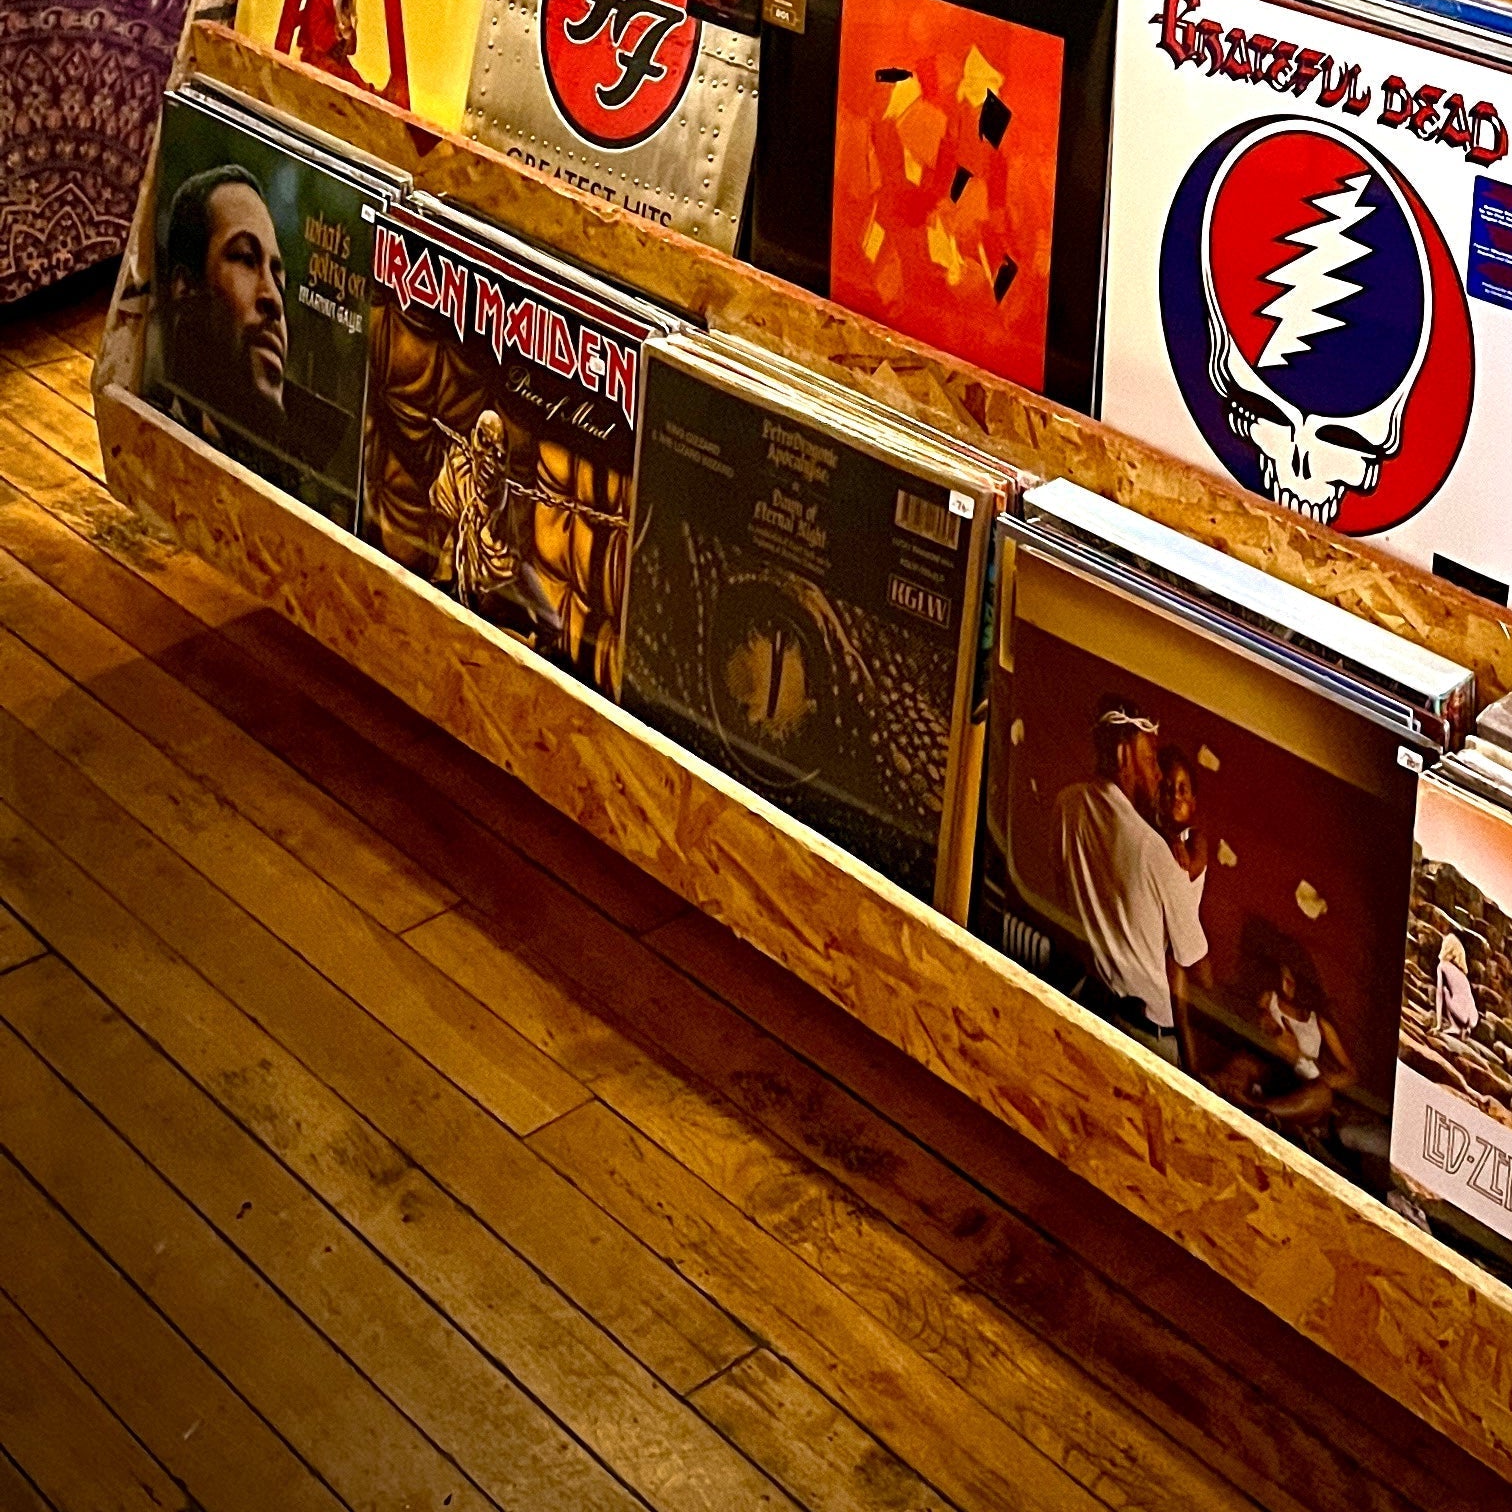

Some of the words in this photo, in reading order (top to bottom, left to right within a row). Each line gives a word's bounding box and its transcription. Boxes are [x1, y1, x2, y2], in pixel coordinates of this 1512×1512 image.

[1382, 74, 1512, 168] DEAD
[304, 210, 351, 261] what's
[308, 252, 347, 302] going
[348, 273, 366, 301] on
[374, 224, 469, 343] IRON
[474, 274, 638, 431] MAIDEN
[569, 401, 617, 441] Mind
[890, 578, 949, 624] KGLW
[1422, 1104, 1471, 1176] LED
